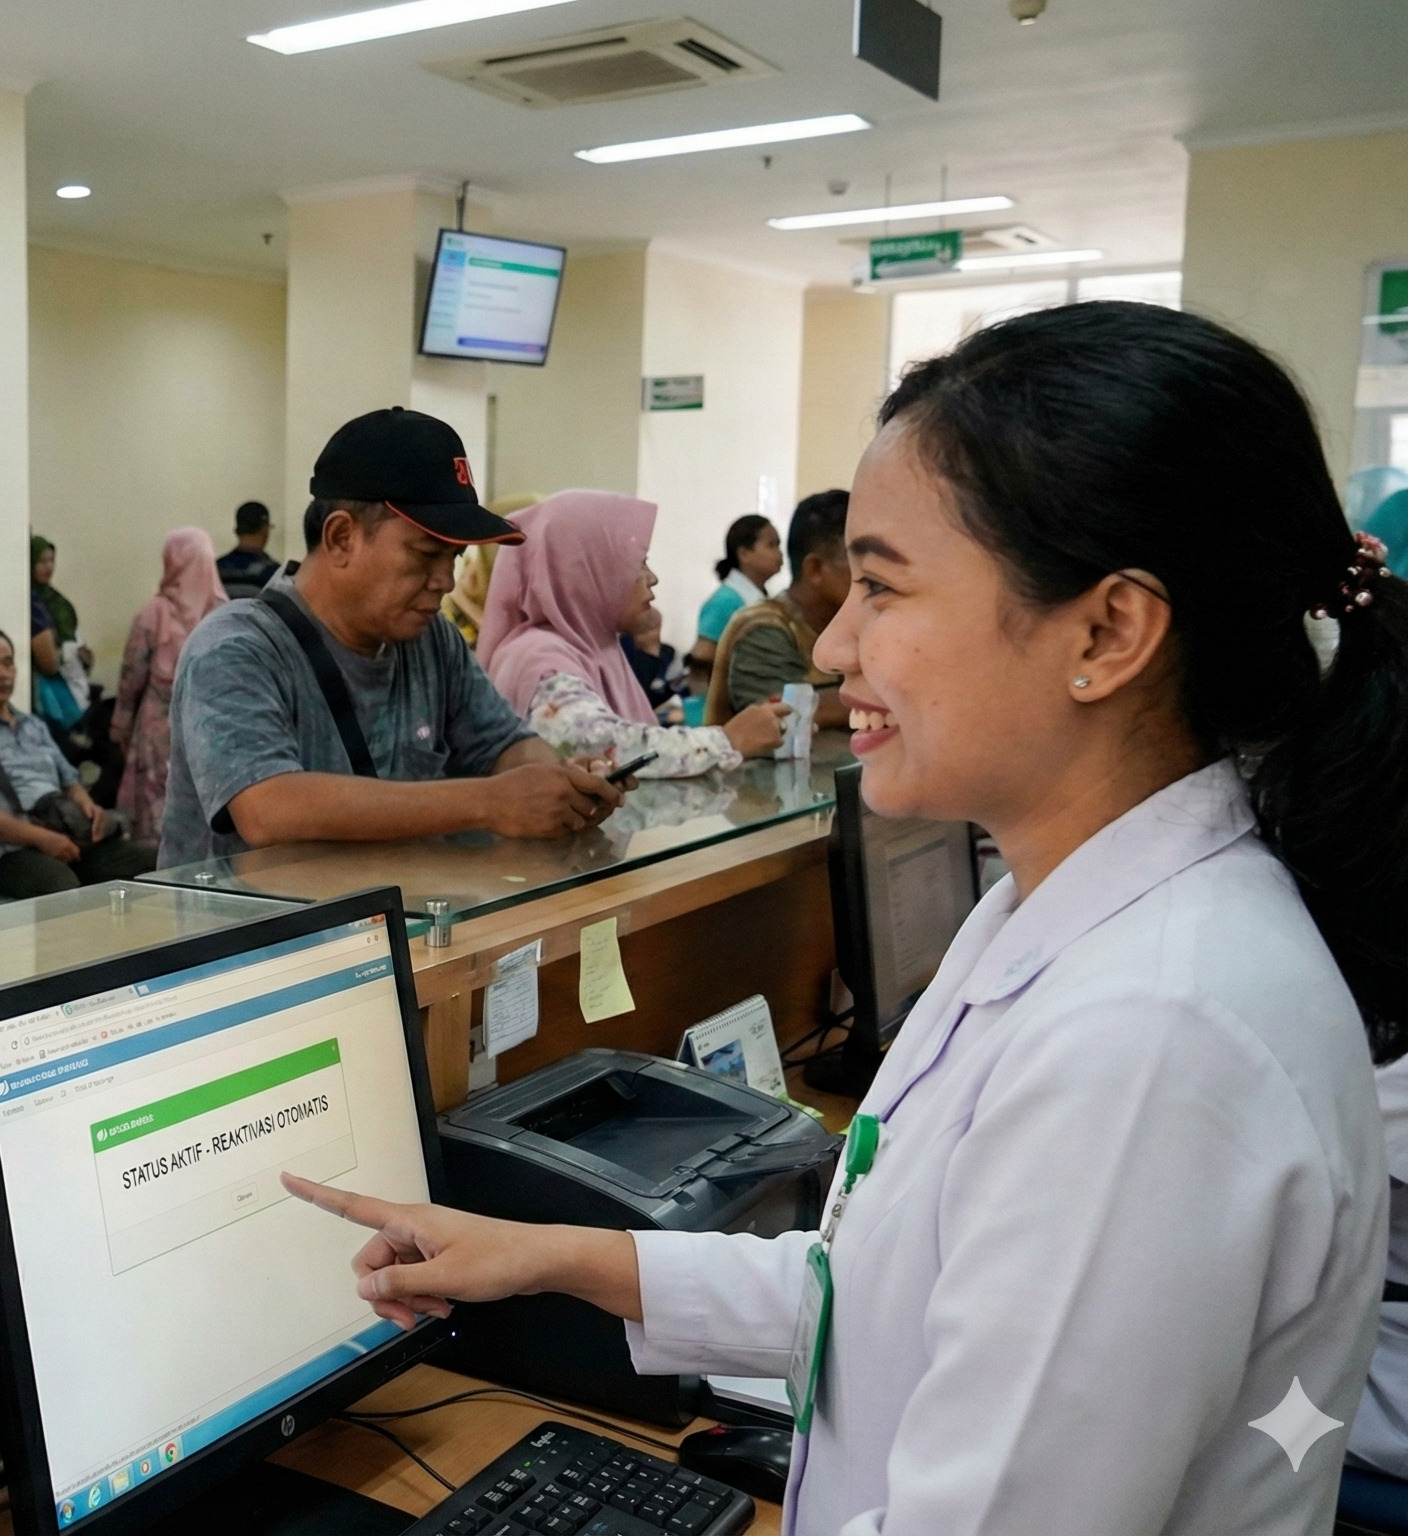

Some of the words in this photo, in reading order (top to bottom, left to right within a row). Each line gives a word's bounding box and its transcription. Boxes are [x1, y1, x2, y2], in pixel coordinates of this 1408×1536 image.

[122, 1157, 169, 1190] STATUS
[170, 1142, 204, 1172] AKTIF
[212, 1115, 276, 1155] REAKTIVASI
[277, 1094, 330, 1129] OTOMATIS
